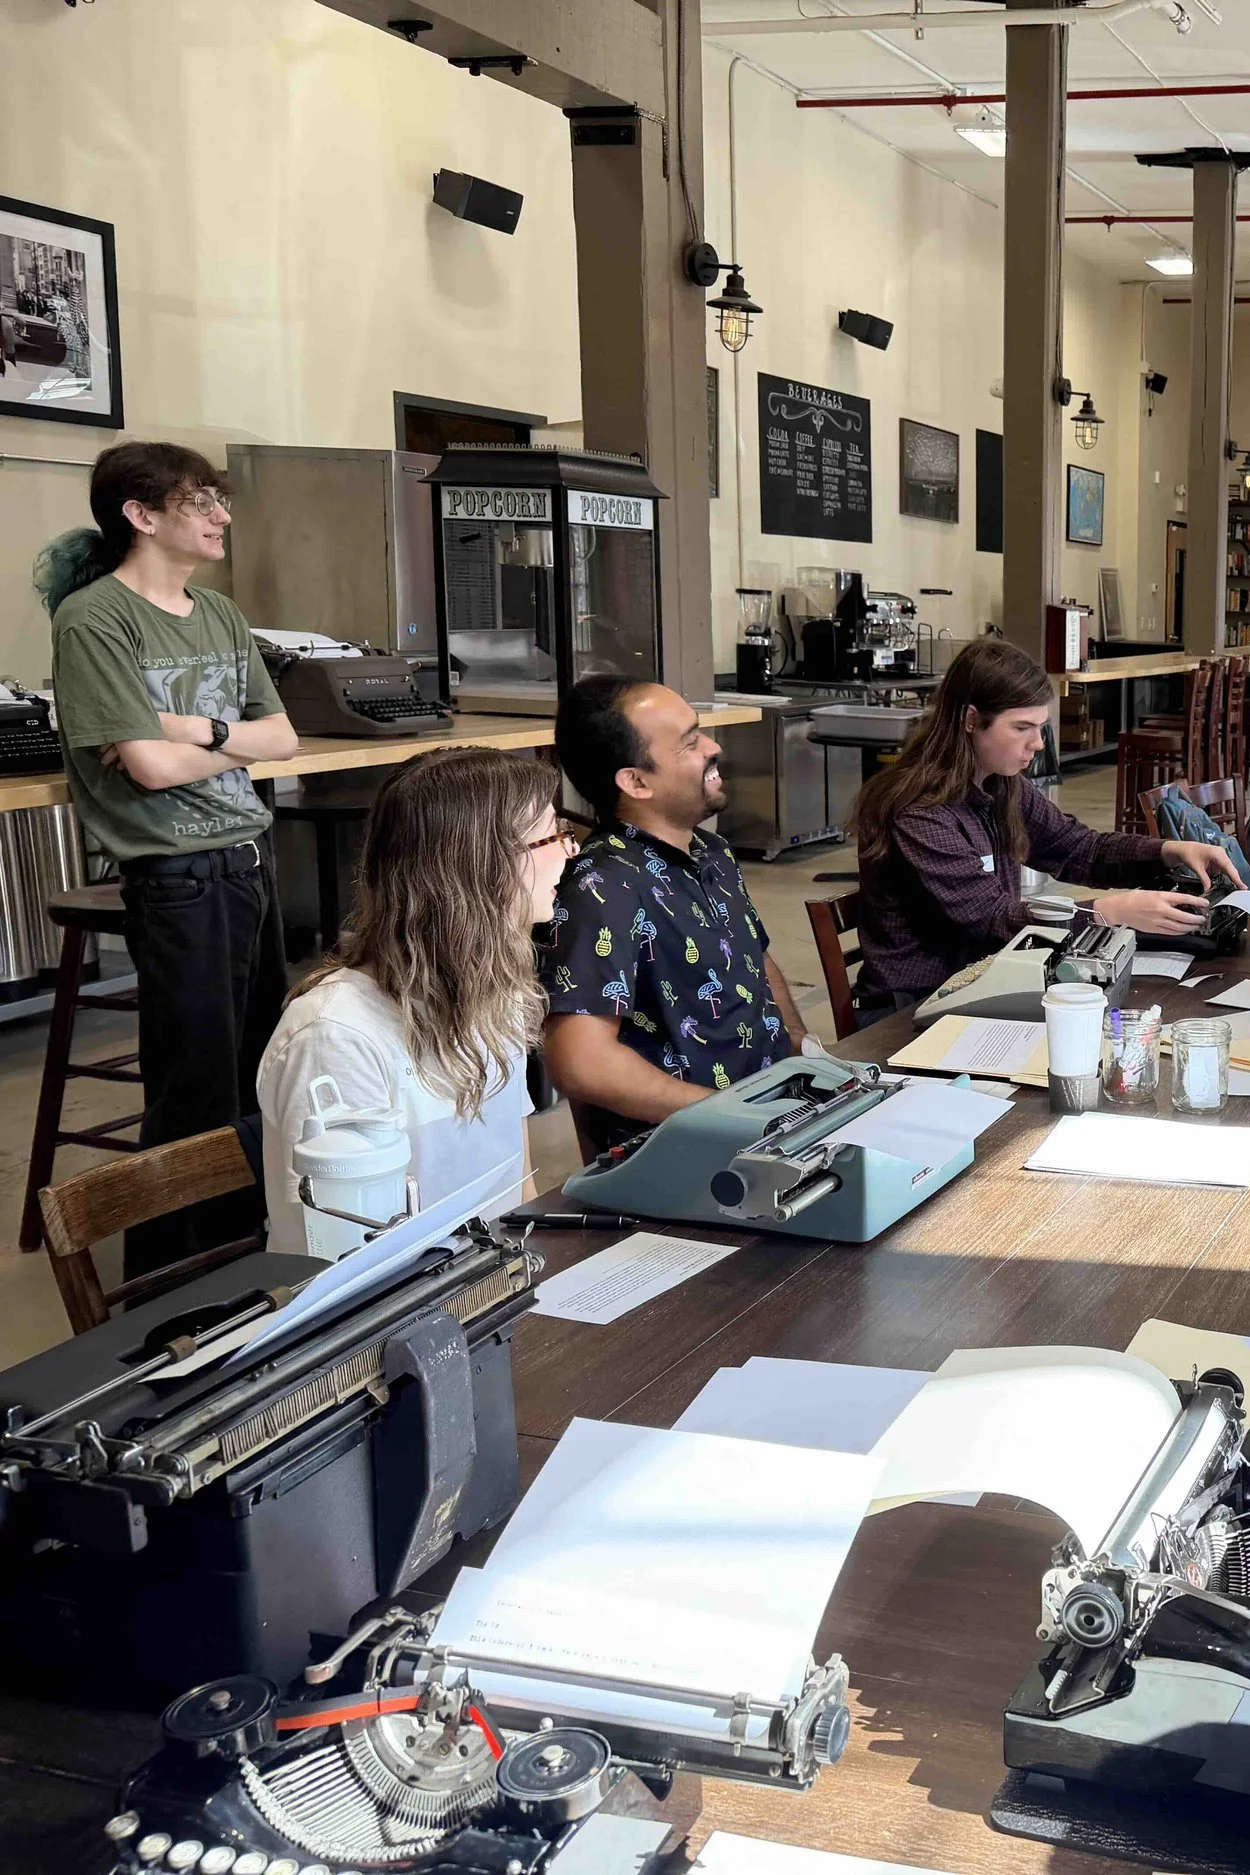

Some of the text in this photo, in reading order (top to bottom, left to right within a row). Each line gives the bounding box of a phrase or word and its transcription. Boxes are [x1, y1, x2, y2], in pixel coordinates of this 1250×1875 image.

[788, 383, 843, 409] BEVERAGES
[448, 490, 547, 518] POPCORN
[580, 495, 642, 525] POPCORN
[153, 657, 174, 668] you
